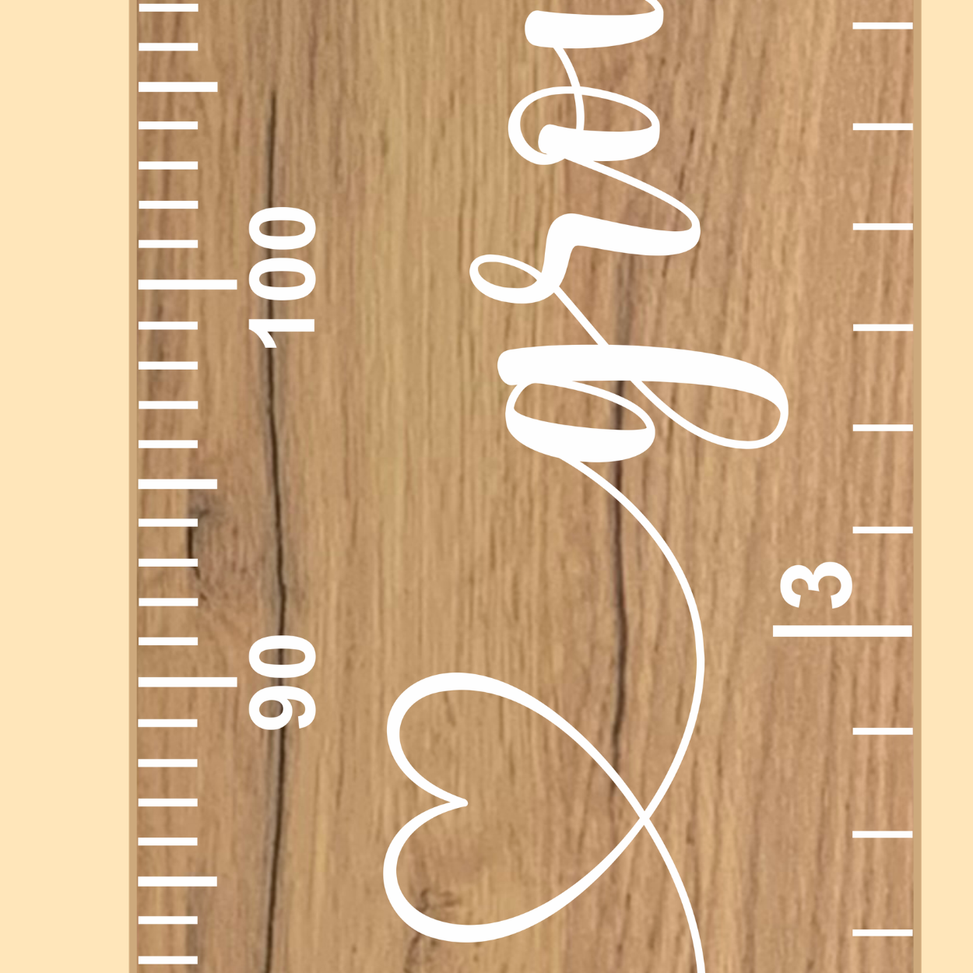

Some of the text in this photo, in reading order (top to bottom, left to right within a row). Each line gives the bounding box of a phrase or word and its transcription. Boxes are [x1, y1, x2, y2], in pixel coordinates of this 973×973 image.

[248, 206, 316, 348] 100
[780, 561, 853, 609] 3
[248, 635, 316, 730] 90
